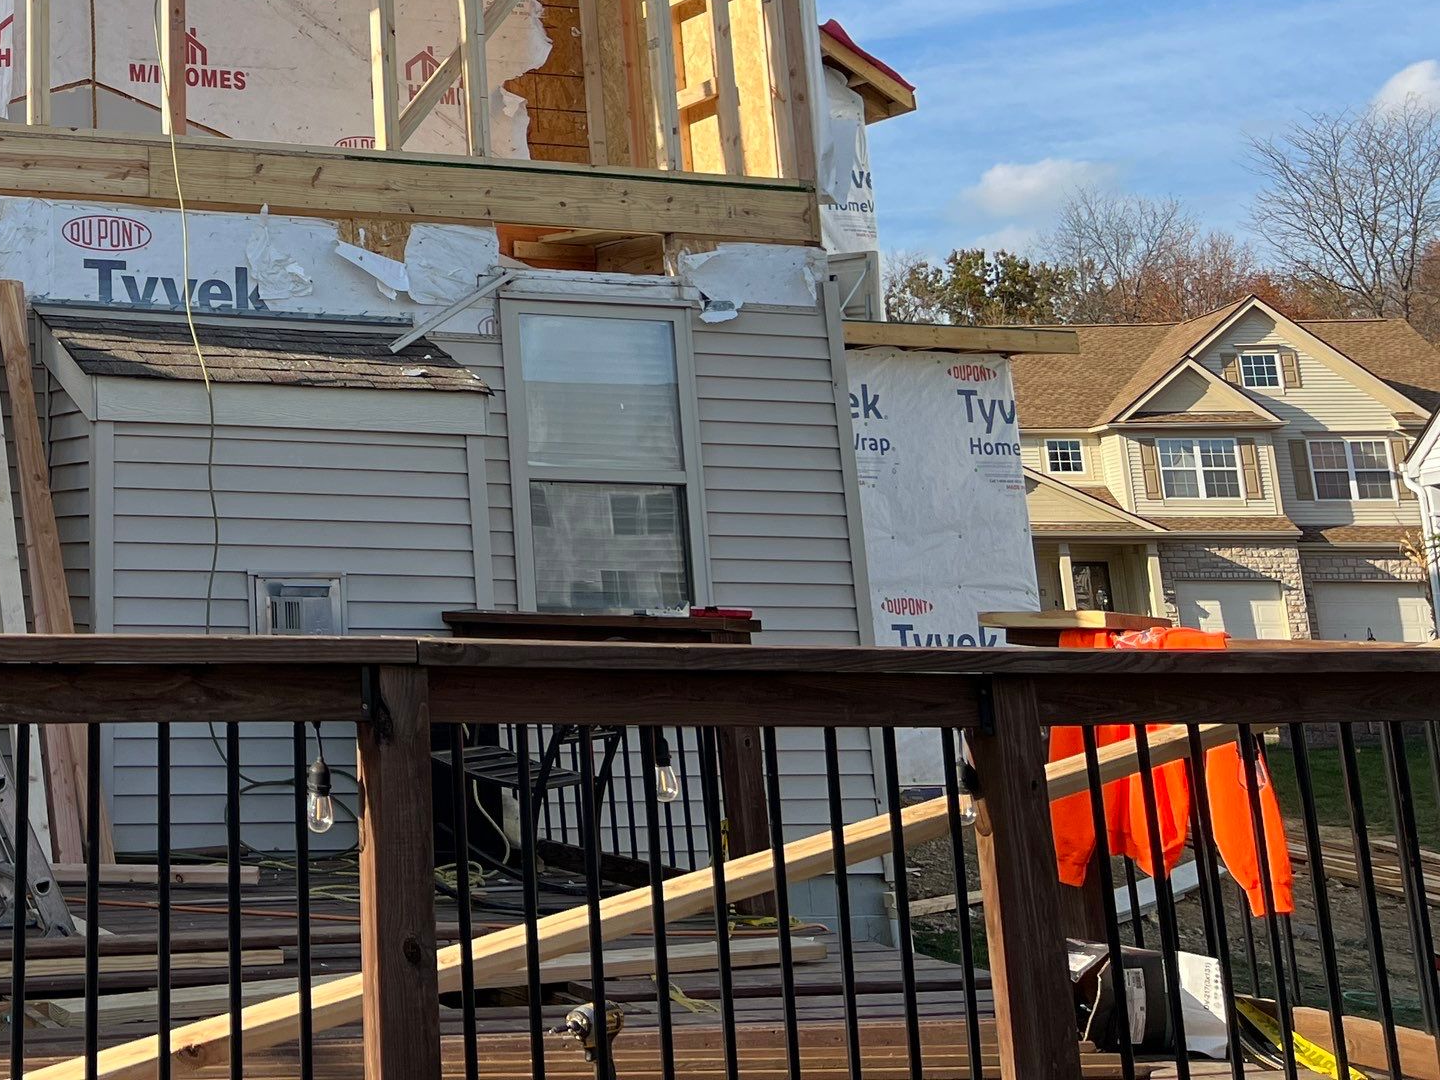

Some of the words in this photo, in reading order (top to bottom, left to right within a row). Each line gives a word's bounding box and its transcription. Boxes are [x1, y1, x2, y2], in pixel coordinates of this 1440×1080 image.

[83, 258, 270, 311] Tyvek
[953, 364, 991, 382] DUPONT
[887, 597, 928, 616] DUPONT
